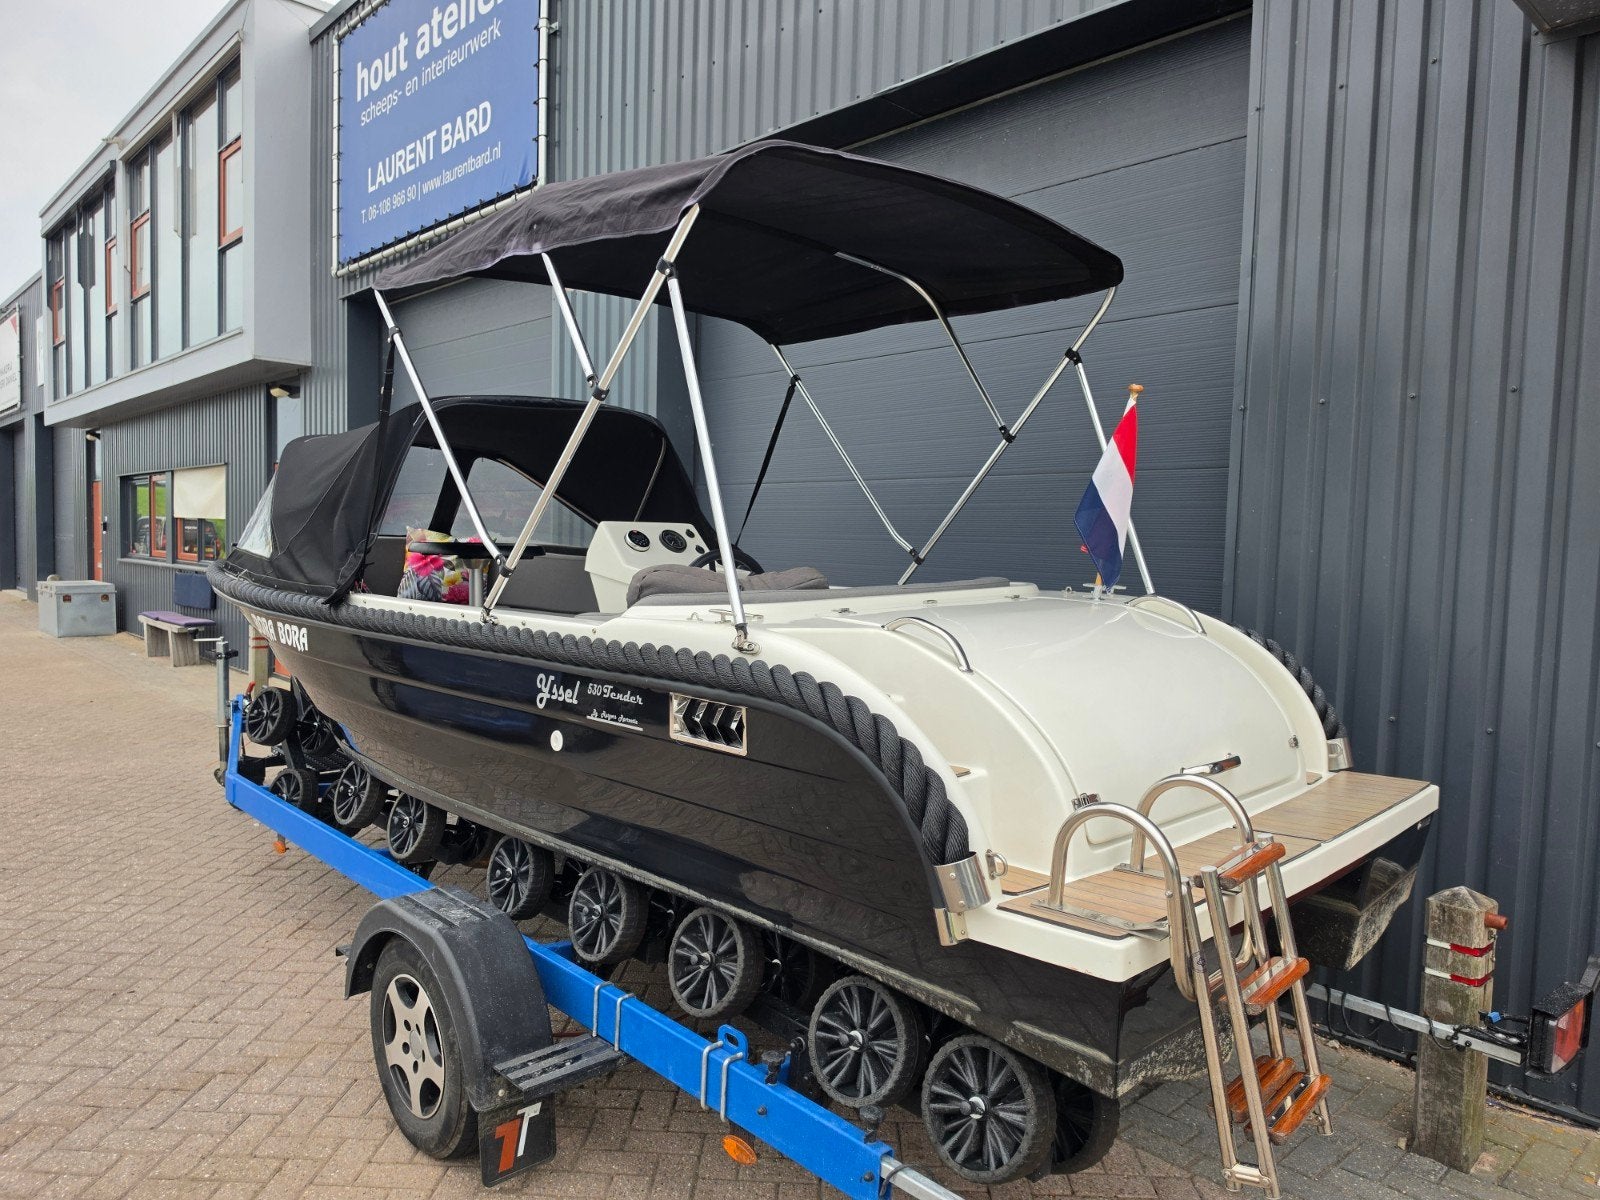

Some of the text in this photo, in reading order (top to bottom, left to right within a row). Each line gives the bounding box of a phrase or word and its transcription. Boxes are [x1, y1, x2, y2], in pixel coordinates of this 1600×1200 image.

[357, 0, 503, 102] hout atel
[361, 17, 501, 126] scheeps- en interieurwerk
[368, 100, 492, 193] LAURENT BARD
[368, 198, 391, 221] 06-108
[407, 184, 417, 202] 90
[422, 141, 501, 194] www.laurentbard.nl
[277, 621, 308, 652] BORA
[587, 682, 643, 705] 530 Tender
